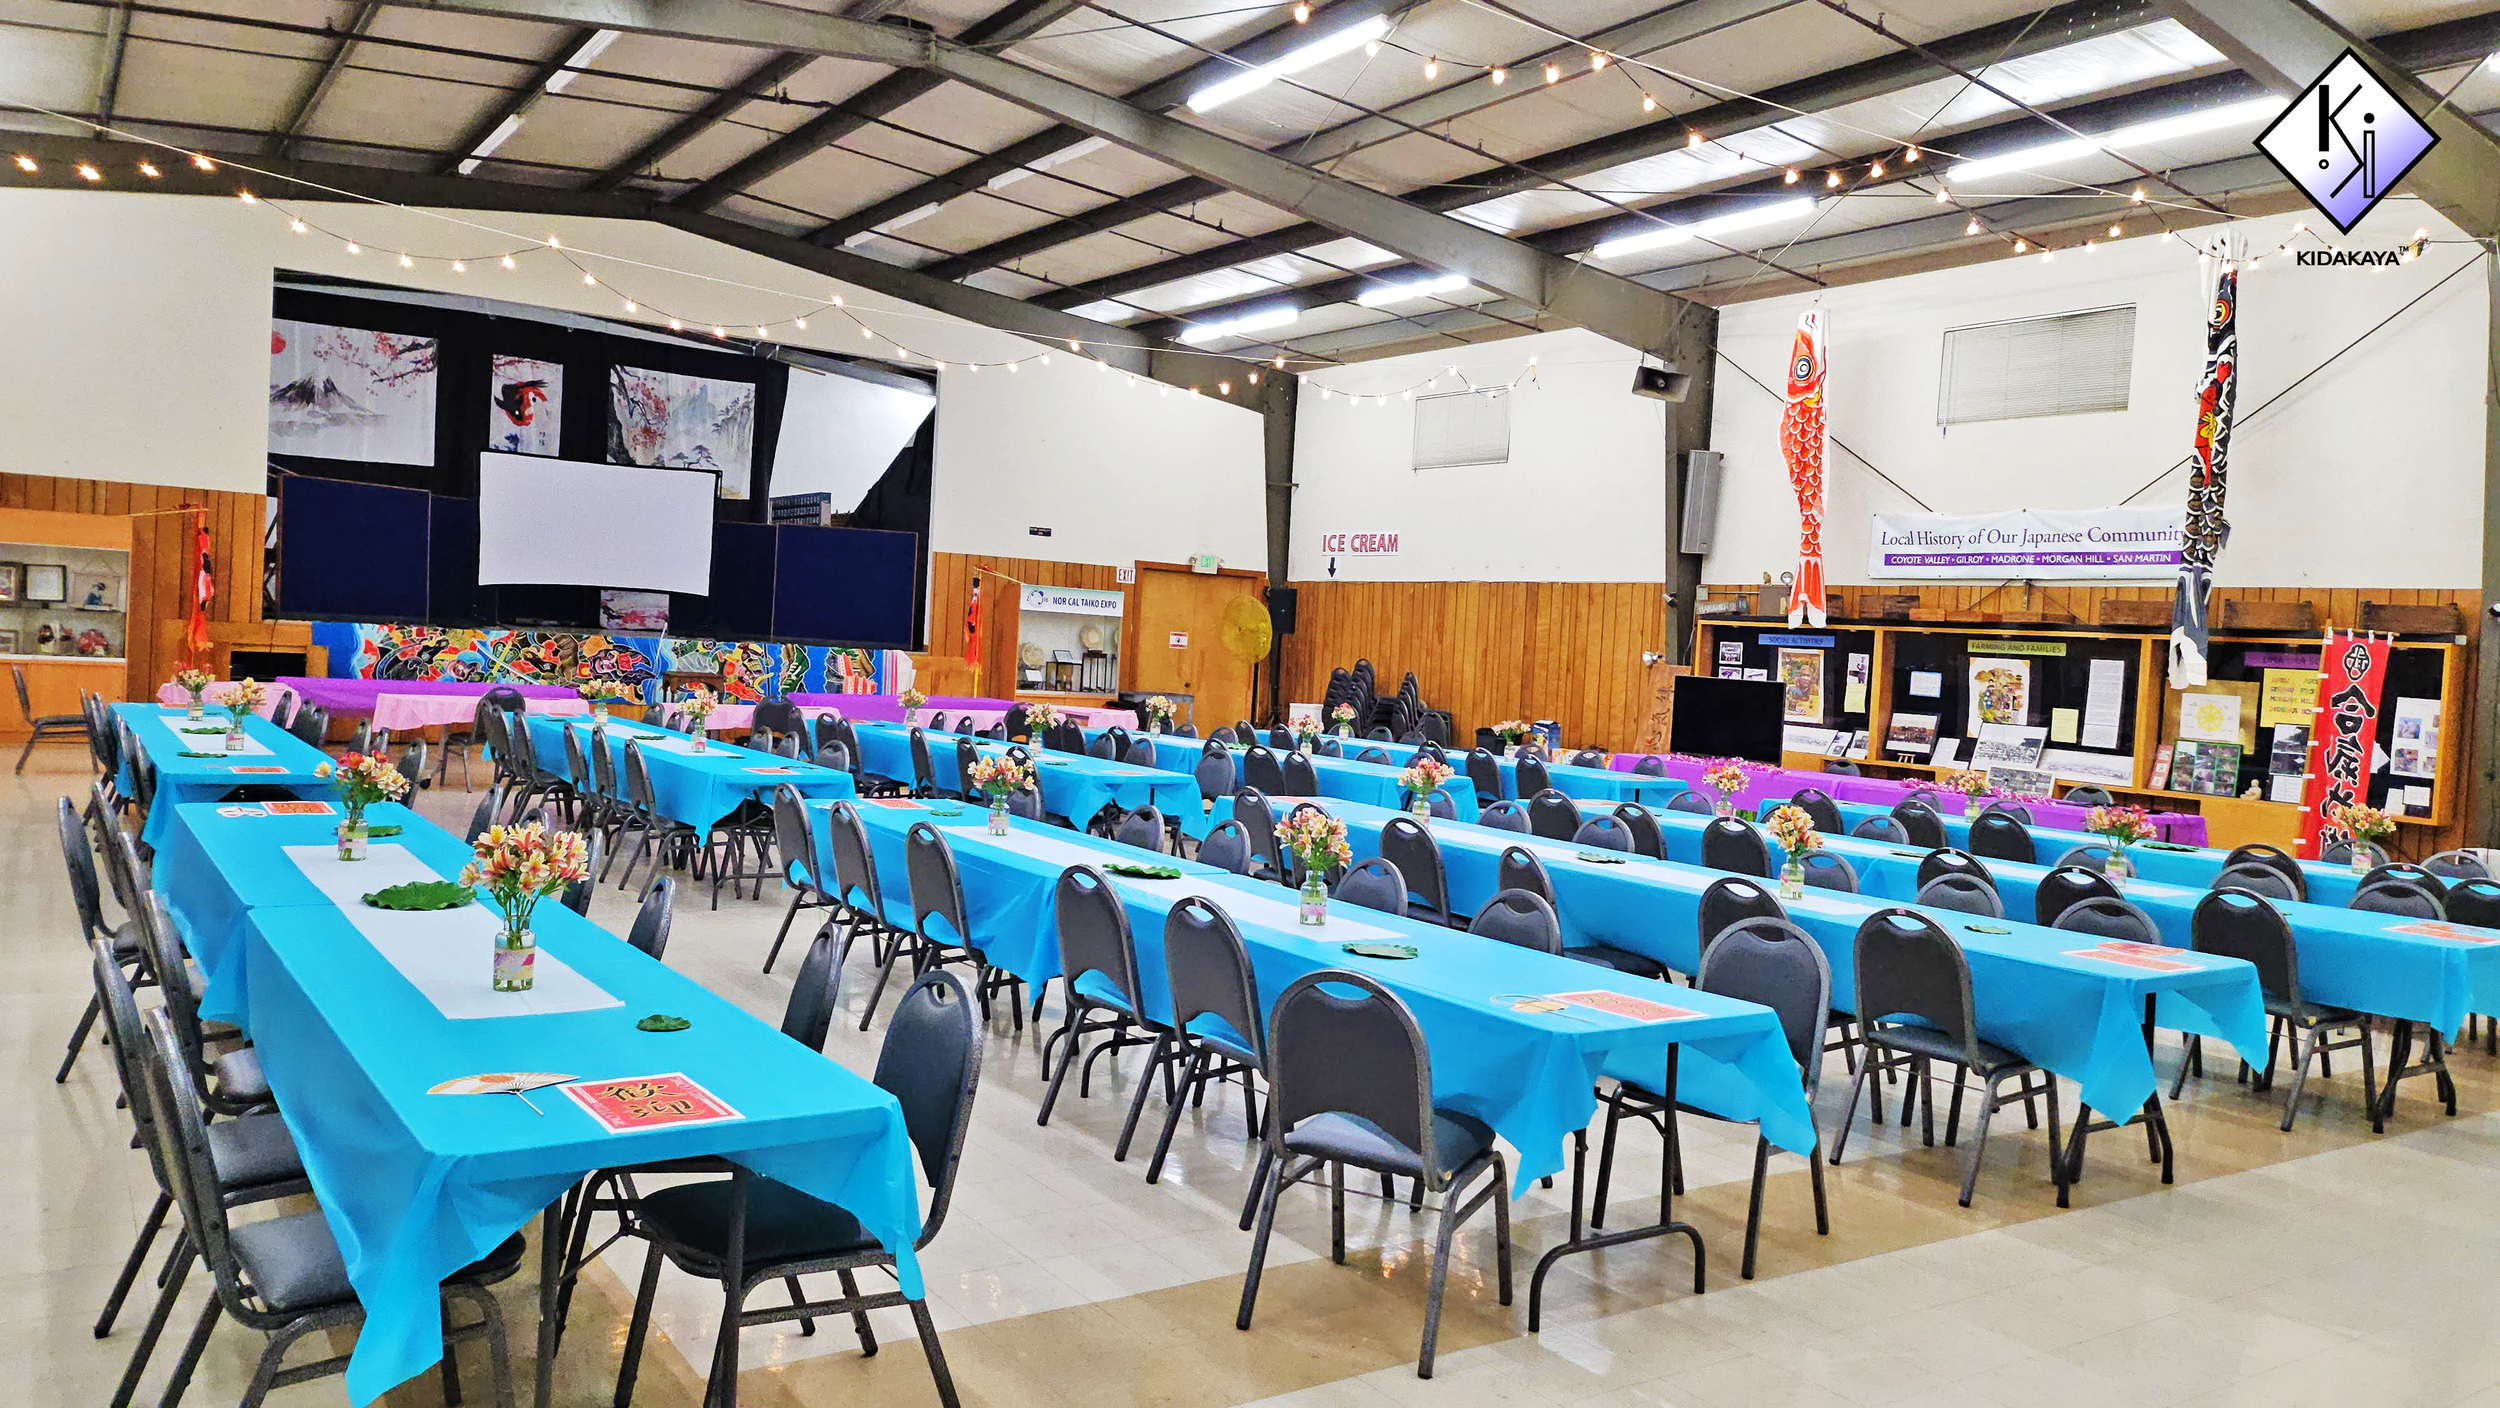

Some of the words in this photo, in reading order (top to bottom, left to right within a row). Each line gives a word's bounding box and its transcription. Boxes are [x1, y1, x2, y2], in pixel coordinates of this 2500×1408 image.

[1322, 534, 1346, 553] ICE
[1350, 533, 1399, 553] CREAM
[1881, 530, 1914, 546] Local
[1916, 530, 1966, 549] History
[1968, 528, 1986, 545] of
[1987, 528, 2018, 544] Our
[2019, 528, 2083, 549] Japanese
[2087, 525, 2186, 546] Community
[1891, 556, 1922, 564] COYOTE
[1924, 556, 1951, 564] VALLEY
[1956, 555, 1985, 564] GILROY
[1990, 554, 2035, 564] MADRONE
[2041, 554, 2083, 563] MORGAN
[2085, 554, 2105, 563] HILL
[2112, 554, 2133, 563] SAN
[2135, 553, 2172, 563] MARTIN
[1118, 568, 1134, 582] EXIT
[1052, 596, 1067, 606] NOR
[1067, 597, 1080, 607] CAL
[1081, 598, 1100, 608] TAIKO
[1100, 600, 1117, 609] EXPO
[1971, 642, 2006, 651] FARMING
[2007, 643, 2025, 652] AND
[2026, 645, 2062, 653] FAMILIES
